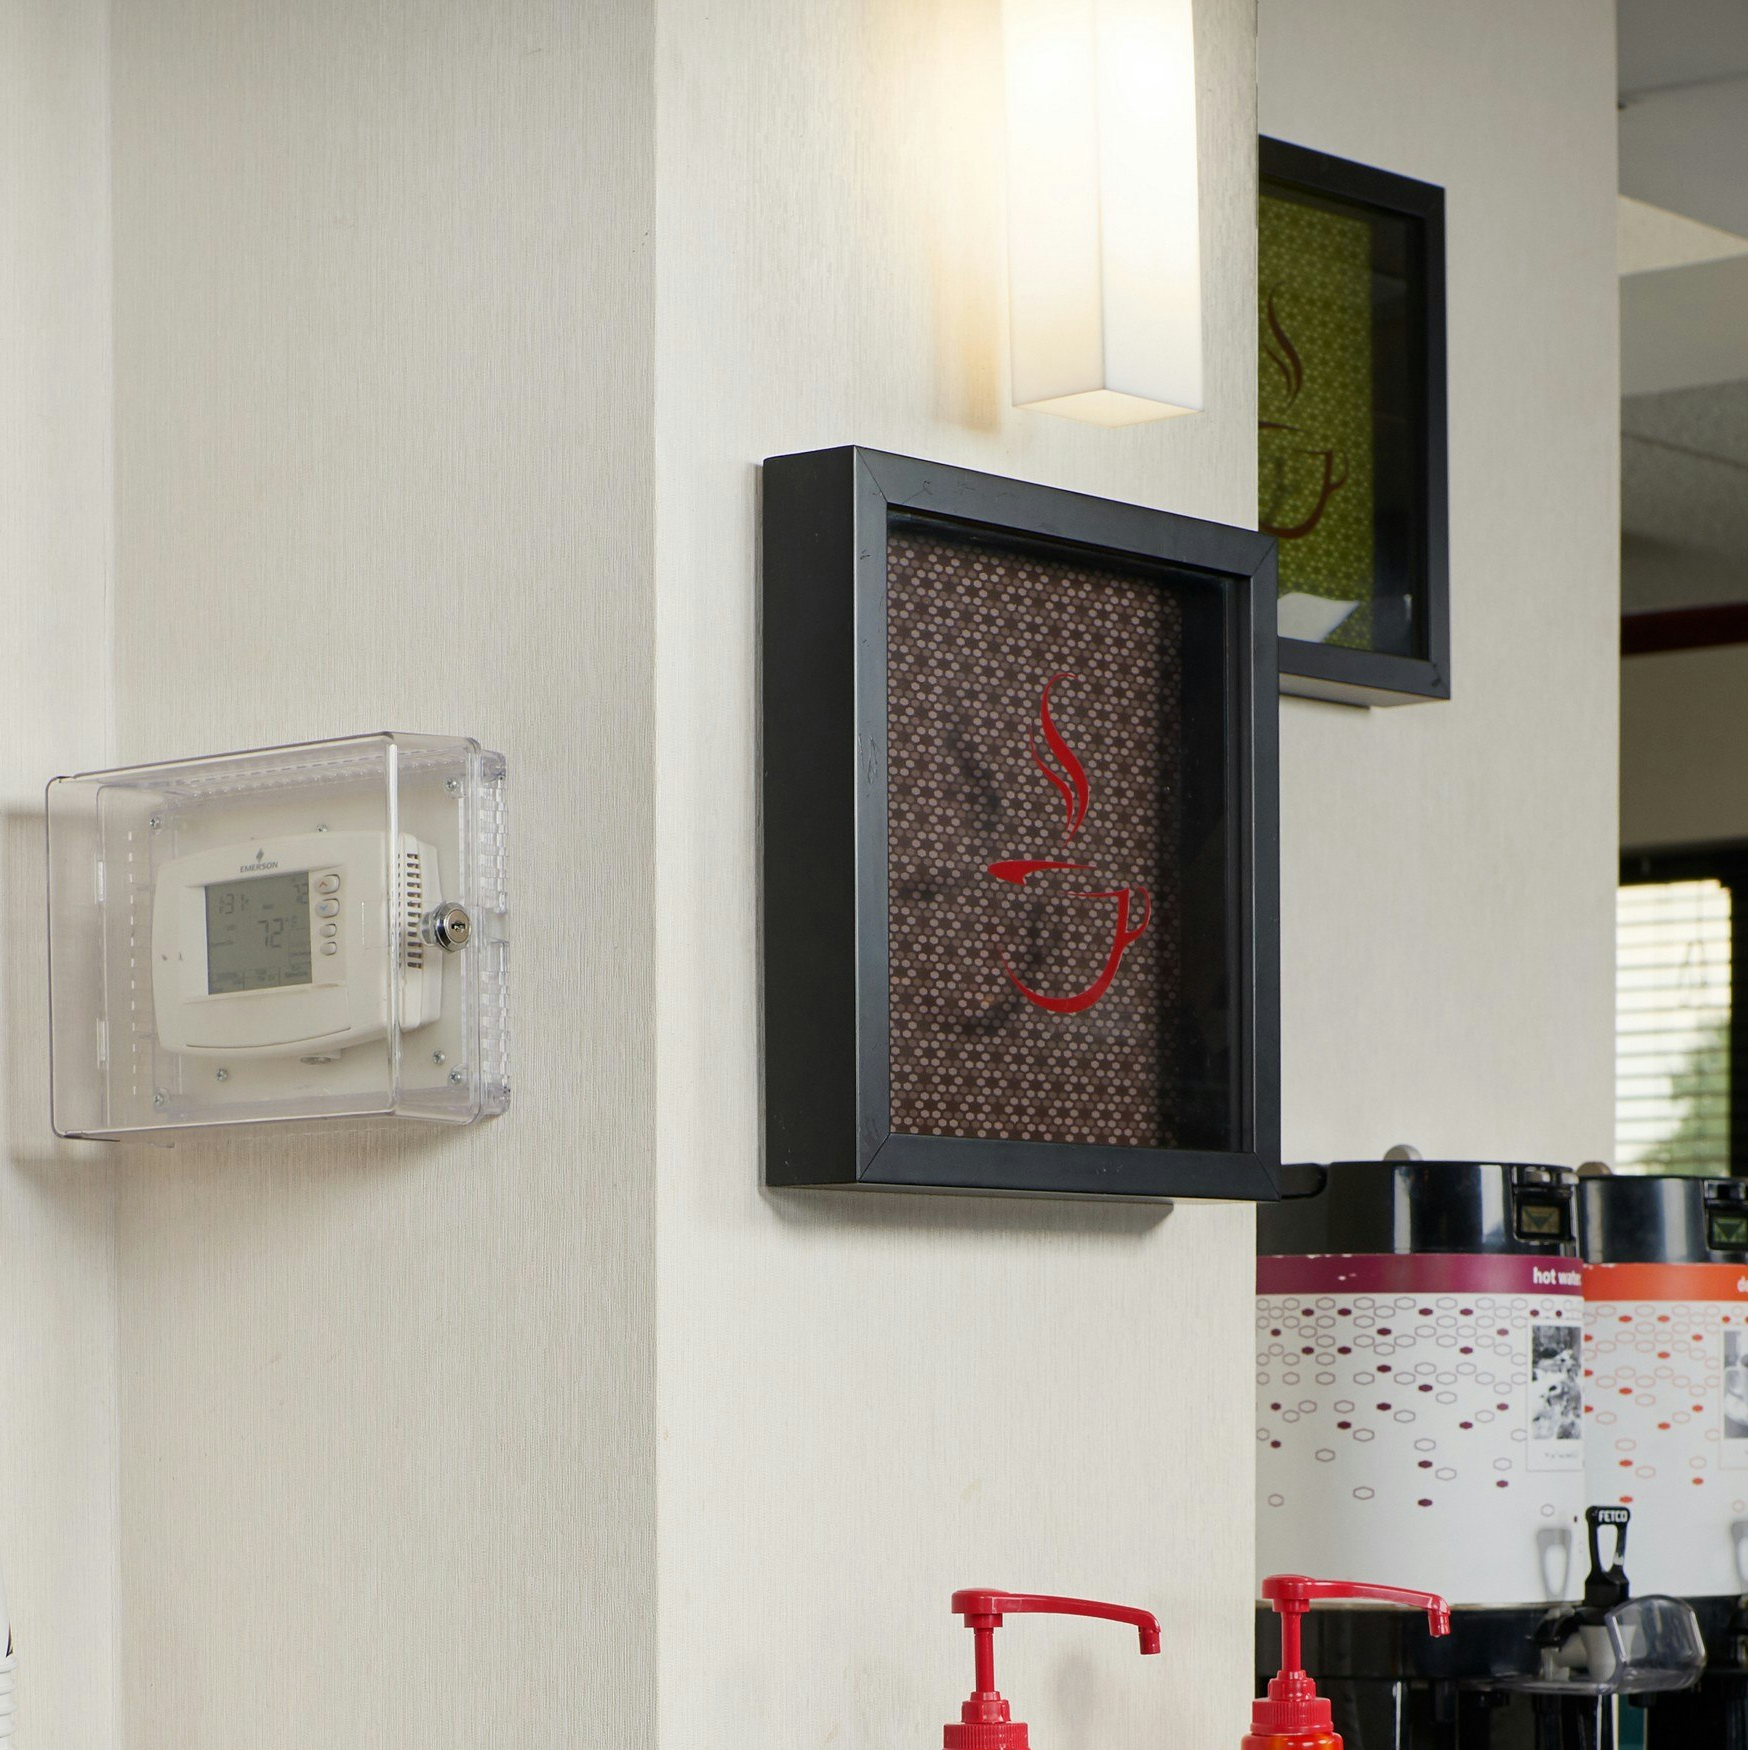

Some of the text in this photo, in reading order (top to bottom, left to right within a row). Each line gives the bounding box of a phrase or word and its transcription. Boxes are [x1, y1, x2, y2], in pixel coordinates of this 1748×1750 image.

[240, 862, 279, 873] EMERSON
[1533, 1266, 1556, 1285] hot
[1598, 1509, 1629, 1523] FETCO
